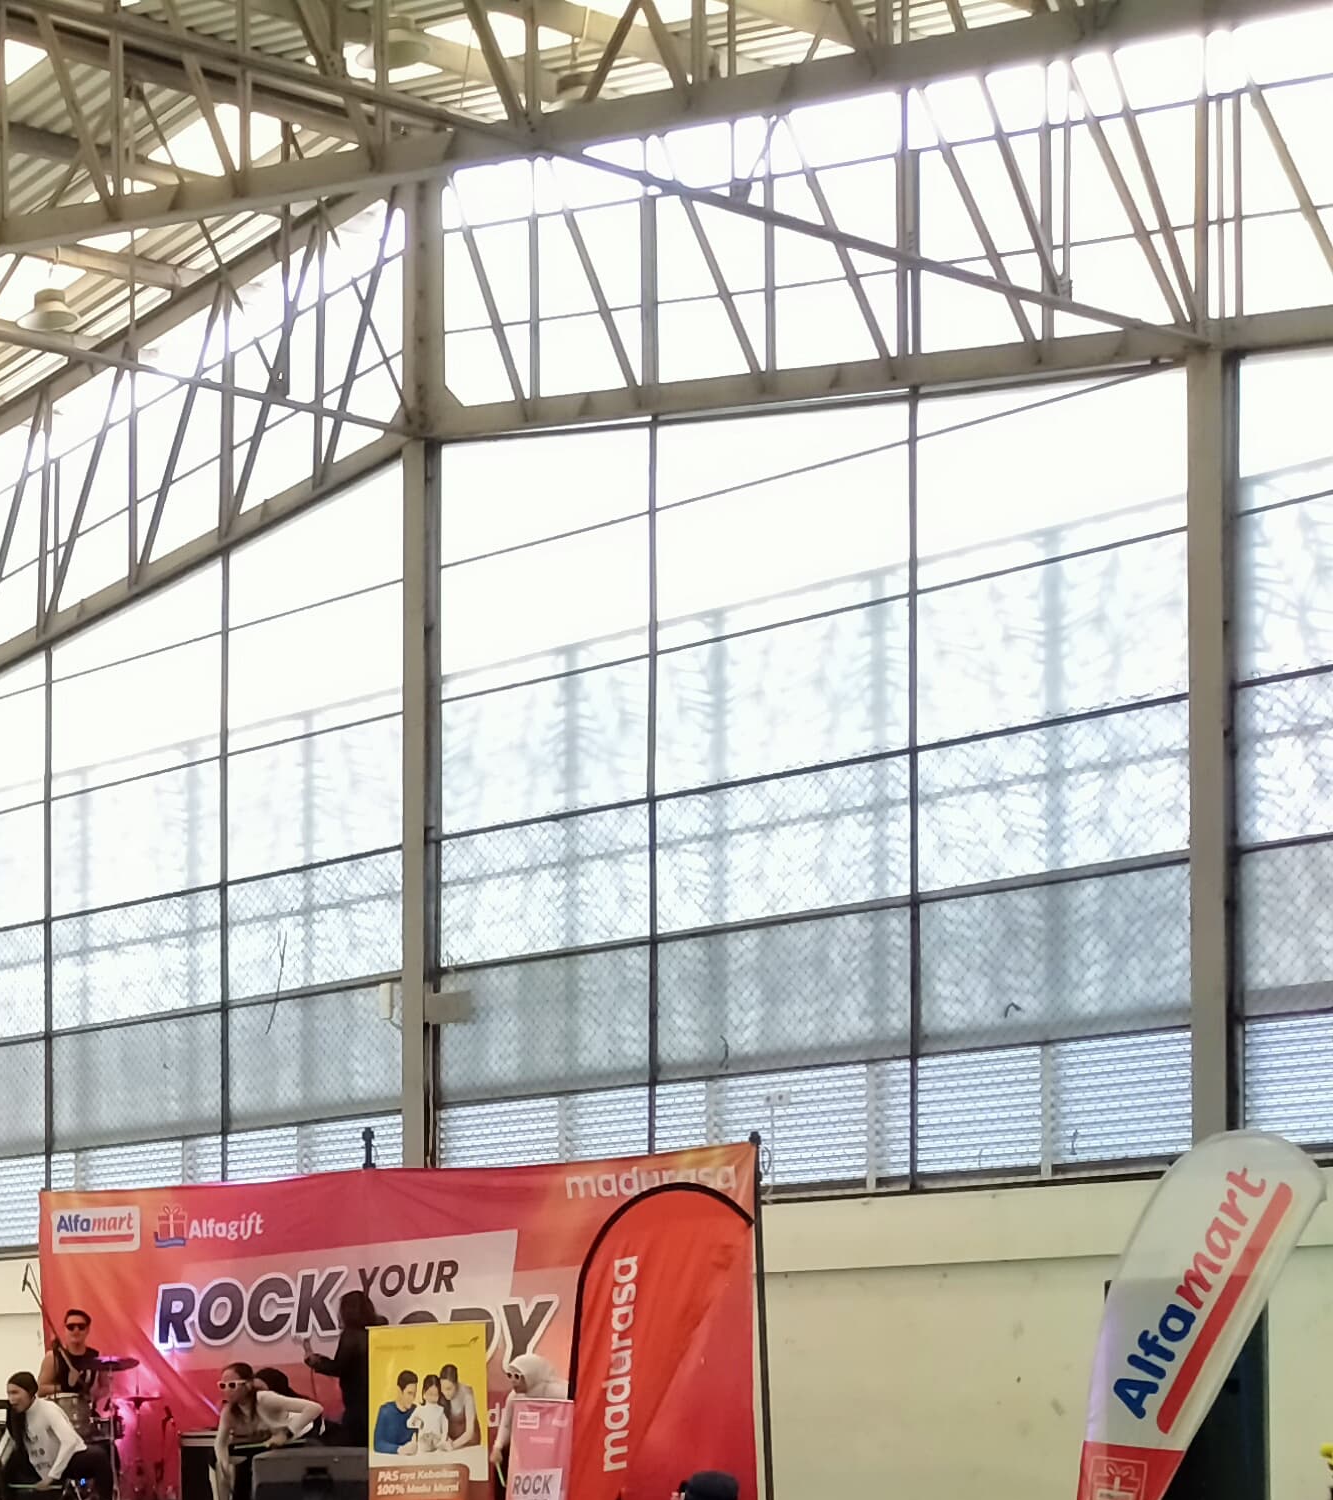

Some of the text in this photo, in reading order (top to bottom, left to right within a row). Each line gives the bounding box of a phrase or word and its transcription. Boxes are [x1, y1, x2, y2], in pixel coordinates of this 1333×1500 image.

[56, 1211, 134, 1233] Alfamart
[188, 1211, 265, 1240] Alfagift
[156, 1260, 459, 1346] ROCK YOUR
[1113, 1167, 1267, 1420] Alfamart
[602, 1255, 639, 1472] madurasa
[377, 1470, 399, 1482] PAS
[512, 1474, 553, 1495] ROCK
